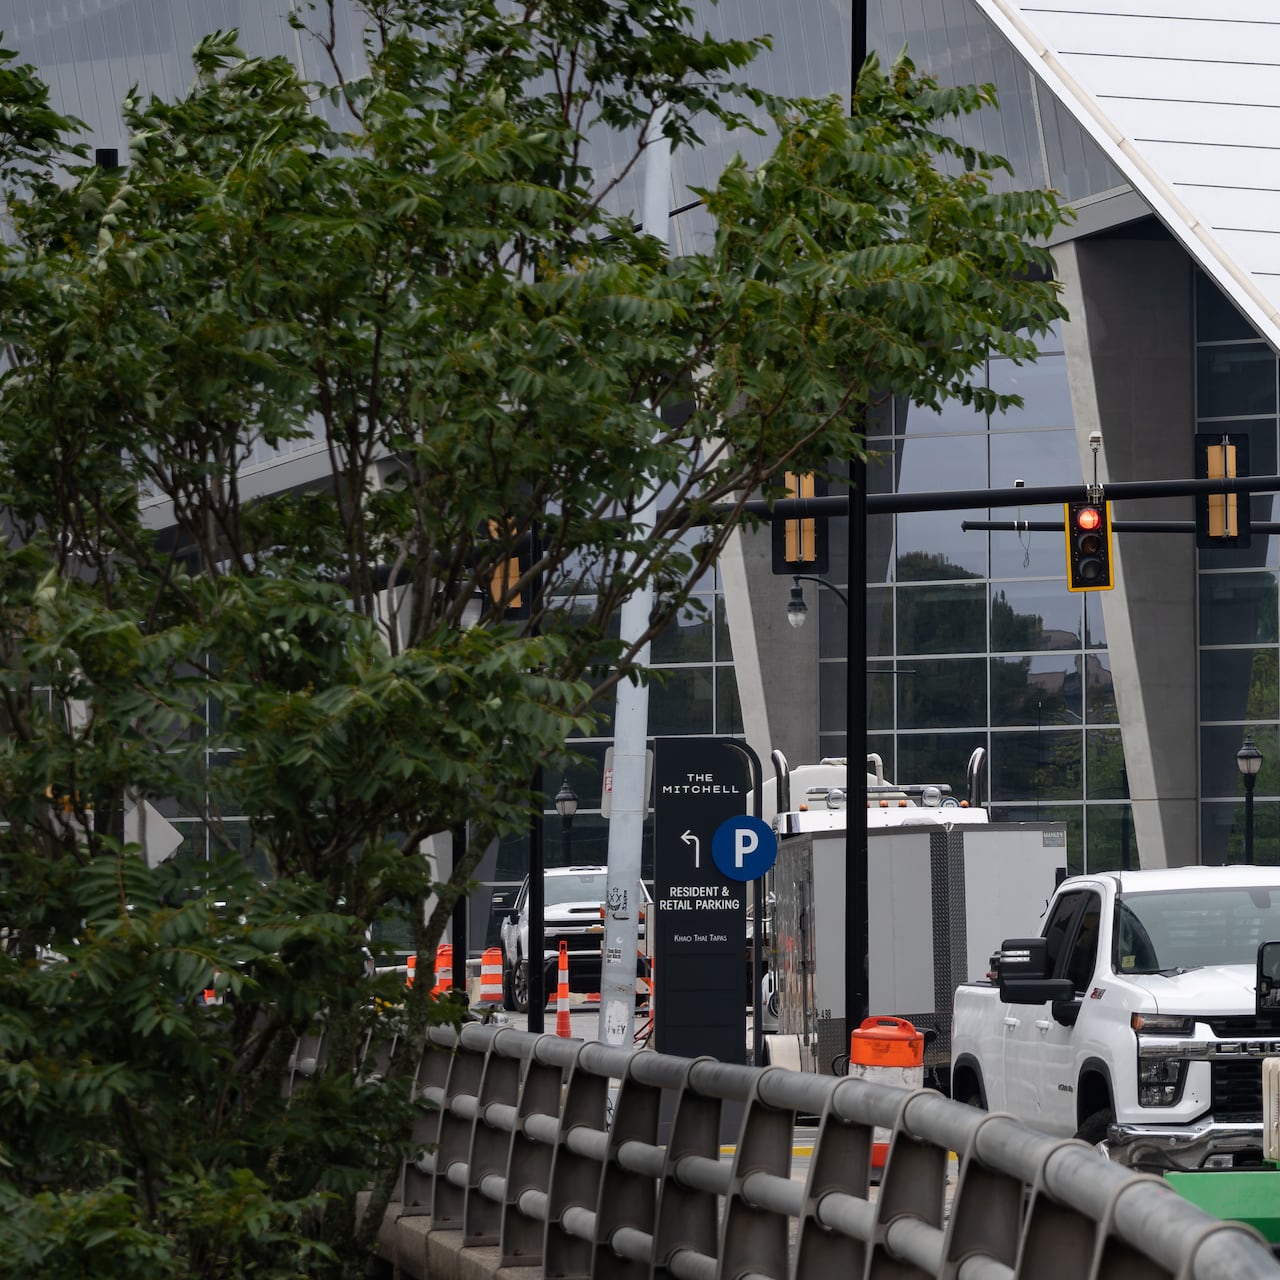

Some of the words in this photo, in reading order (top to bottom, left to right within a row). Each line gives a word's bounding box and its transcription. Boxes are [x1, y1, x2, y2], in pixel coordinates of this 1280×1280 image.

[686, 773, 714, 782] THE
[662, 785, 740, 794] MITCHELL
[735, 828, 759, 868] P
[669, 886, 719, 897] RESIDENT
[721, 886, 730, 897] &
[659, 899, 693, 910] RETAIL
[695, 899, 740, 910] PARKING
